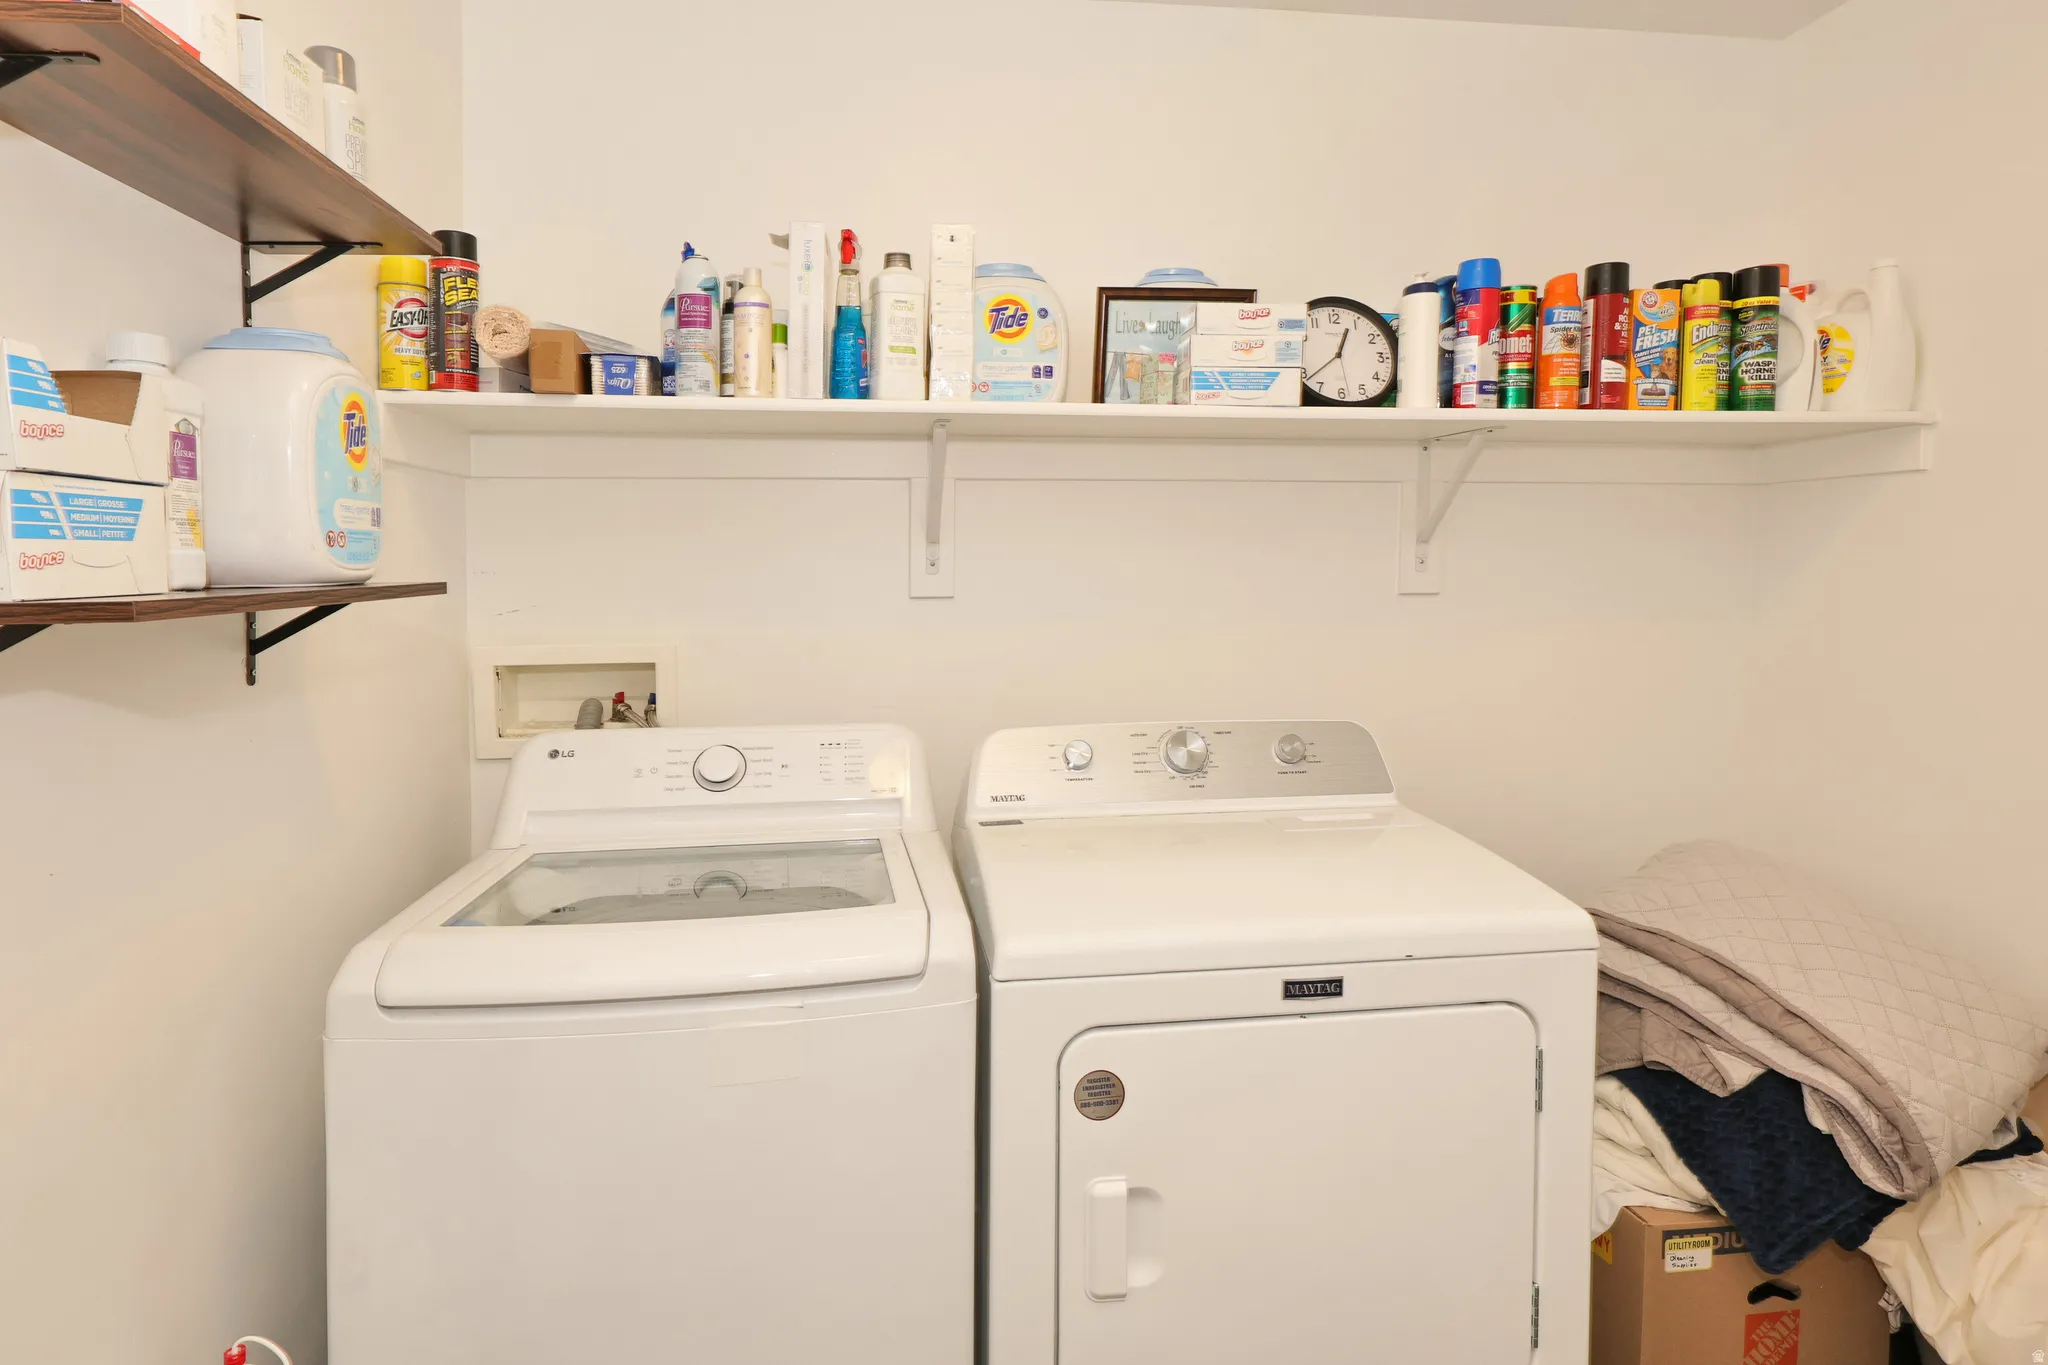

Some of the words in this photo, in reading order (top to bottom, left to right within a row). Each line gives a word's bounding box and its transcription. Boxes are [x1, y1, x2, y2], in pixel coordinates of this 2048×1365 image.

[443, 276, 478, 292] FLE
[444, 289, 479, 307] SEA
[681, 296, 709, 312] Pursue
[890, 304, 915, 312] home
[1239, 308, 1271, 320] bounce
[389, 308, 428, 328] EASY-OF
[988, 306, 1029, 334] Tide
[1328, 313, 1340, 325] 12
[1553, 309, 1581, 322] TERR
[1115, 310, 1138, 334] Live
[1149, 312, 1181, 340] Laugh
[1310, 318, 1319, 329] 11
[1353, 319, 1357, 330] 1
[1550, 326, 1572, 334] Spider
[1638, 323, 1657, 338] PET
[1692, 321, 1719, 346] Endu
[1367, 333, 1376, 344] 2
[1499, 334, 1532, 354] omet
[1635, 329, 1679, 351] FRESH
[1232, 340, 1264, 351] bounce
[1376, 352, 1385, 363] 3
[611, 366, 628, 374] 625
[1372, 371, 1380, 382] 4
[1316, 382, 1324, 393] 7
[1337, 388, 1346, 399] 6
[1358, 384, 1366, 395] 5
[20, 420, 65, 440] bounce
[343, 411, 367, 454] Tide
[69, 497, 94, 506] LARGE
[97, 499, 127, 509] GROSSE
[70, 512, 100, 522] MEDIUM
[103, 514, 136, 523] MOYENNE
[73, 529, 99, 538] SMALL
[102, 529, 126, 538] PETITE
[19, 551, 65, 570] bounce
[990, 794, 1025, 802] MAYTAG
[1286, 982, 1340, 995] MAYTAG
[1668, 1241, 1693, 1250] UTILITY
[1692, 1240, 1710, 1249] ROOM
[1749, 1319, 1771, 1342] THE
[1743, 1310, 1799, 1365] HOME
